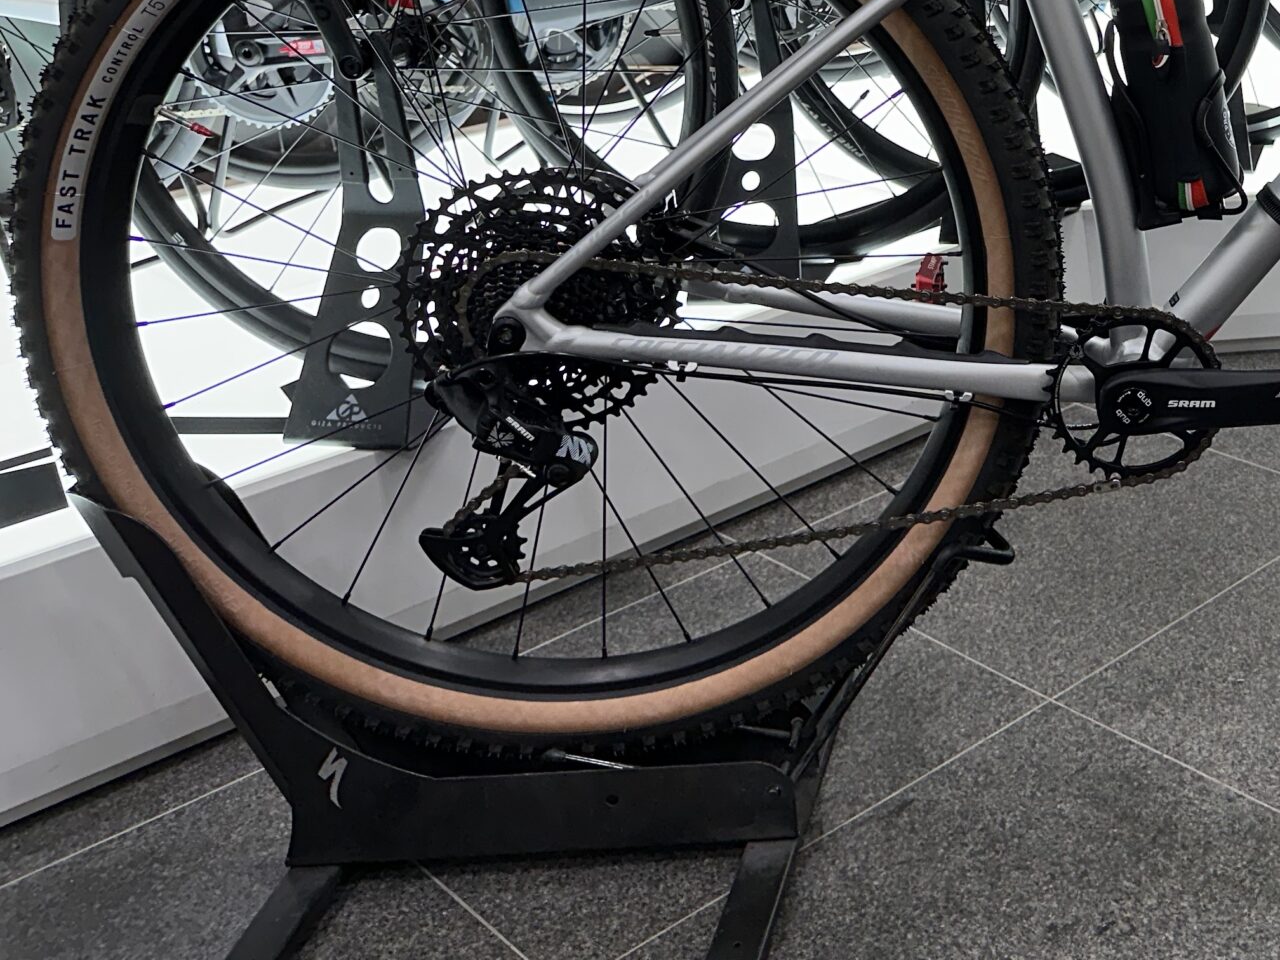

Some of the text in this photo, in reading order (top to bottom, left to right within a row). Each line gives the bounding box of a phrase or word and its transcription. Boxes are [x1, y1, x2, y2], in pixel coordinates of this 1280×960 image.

[55, 169, 80, 229] FAST
[68, 94, 106, 156] TRAK
[101, 26, 144, 84] CONTROL
[611, 337, 839, 365] SPECIALIZED
[1136, 390, 1153, 407] dub
[1167, 399, 1216, 409] SRAM
[311, 419, 383, 431] GIZA PRODUCTS
[1115, 408, 1131, 425] dub
[505, 416, 535, 441] SRAM
[556, 434, 592, 466] NX
